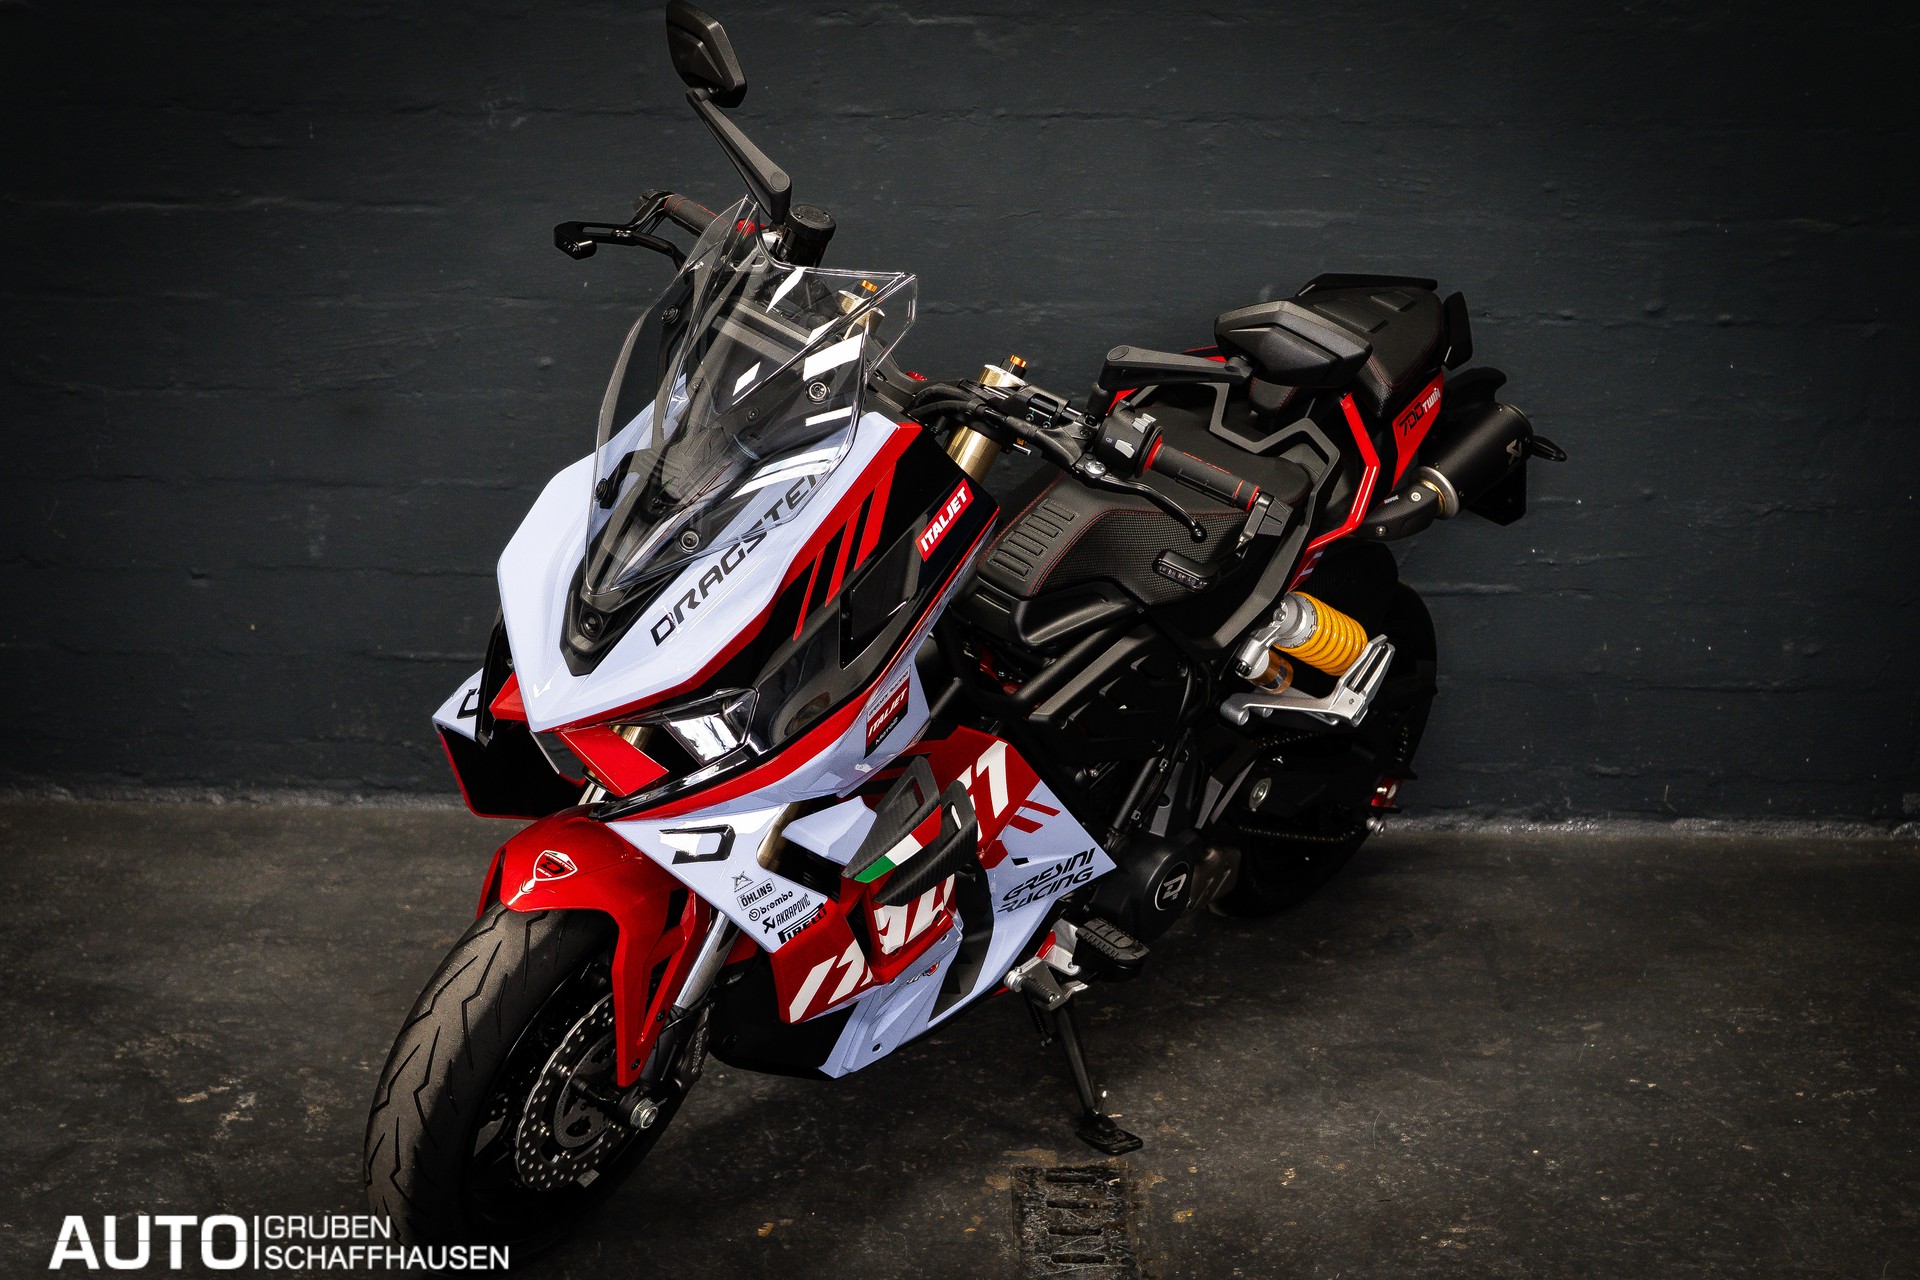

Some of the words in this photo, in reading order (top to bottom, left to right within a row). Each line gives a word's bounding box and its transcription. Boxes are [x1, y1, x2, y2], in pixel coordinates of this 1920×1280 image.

[920, 486, 967, 552] ITALJET
[867, 687, 908, 738] ITALJET
[741, 883, 773, 907] ÖHLINS
[995, 866, 1094, 914] RACING
[1002, 847, 1096, 903] GRESINI
[759, 890, 793, 916] brembo
[777, 902, 828, 945] PIRELLI
